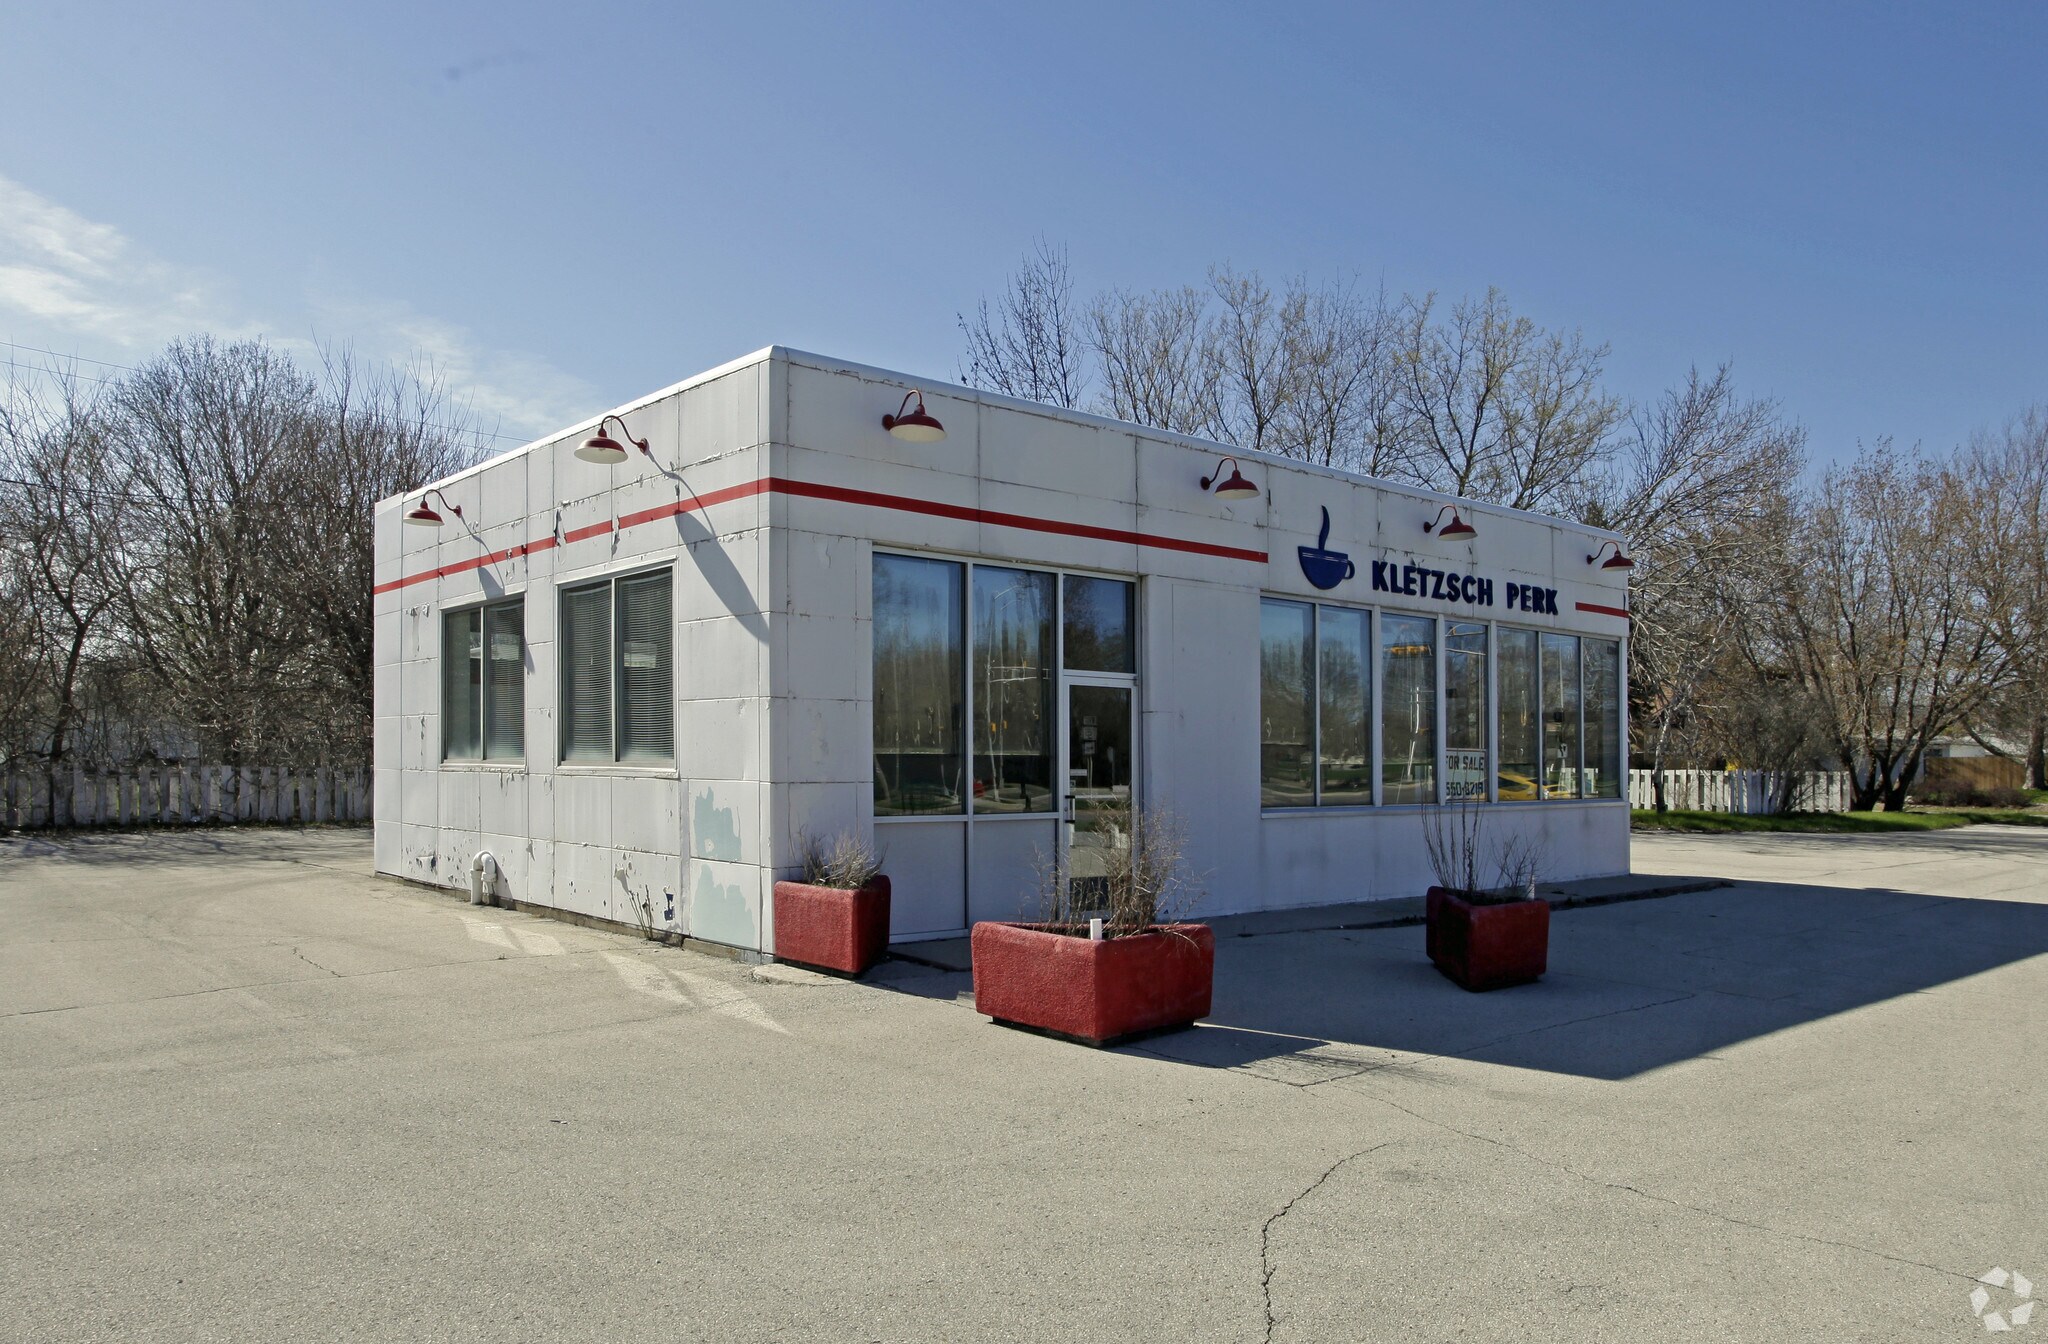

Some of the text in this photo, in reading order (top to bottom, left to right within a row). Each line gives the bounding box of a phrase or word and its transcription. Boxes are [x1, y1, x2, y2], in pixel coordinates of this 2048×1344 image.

[1372, 560, 1559, 615] KLETZSCH PERK
[1462, 755, 1484, 771] SALE
